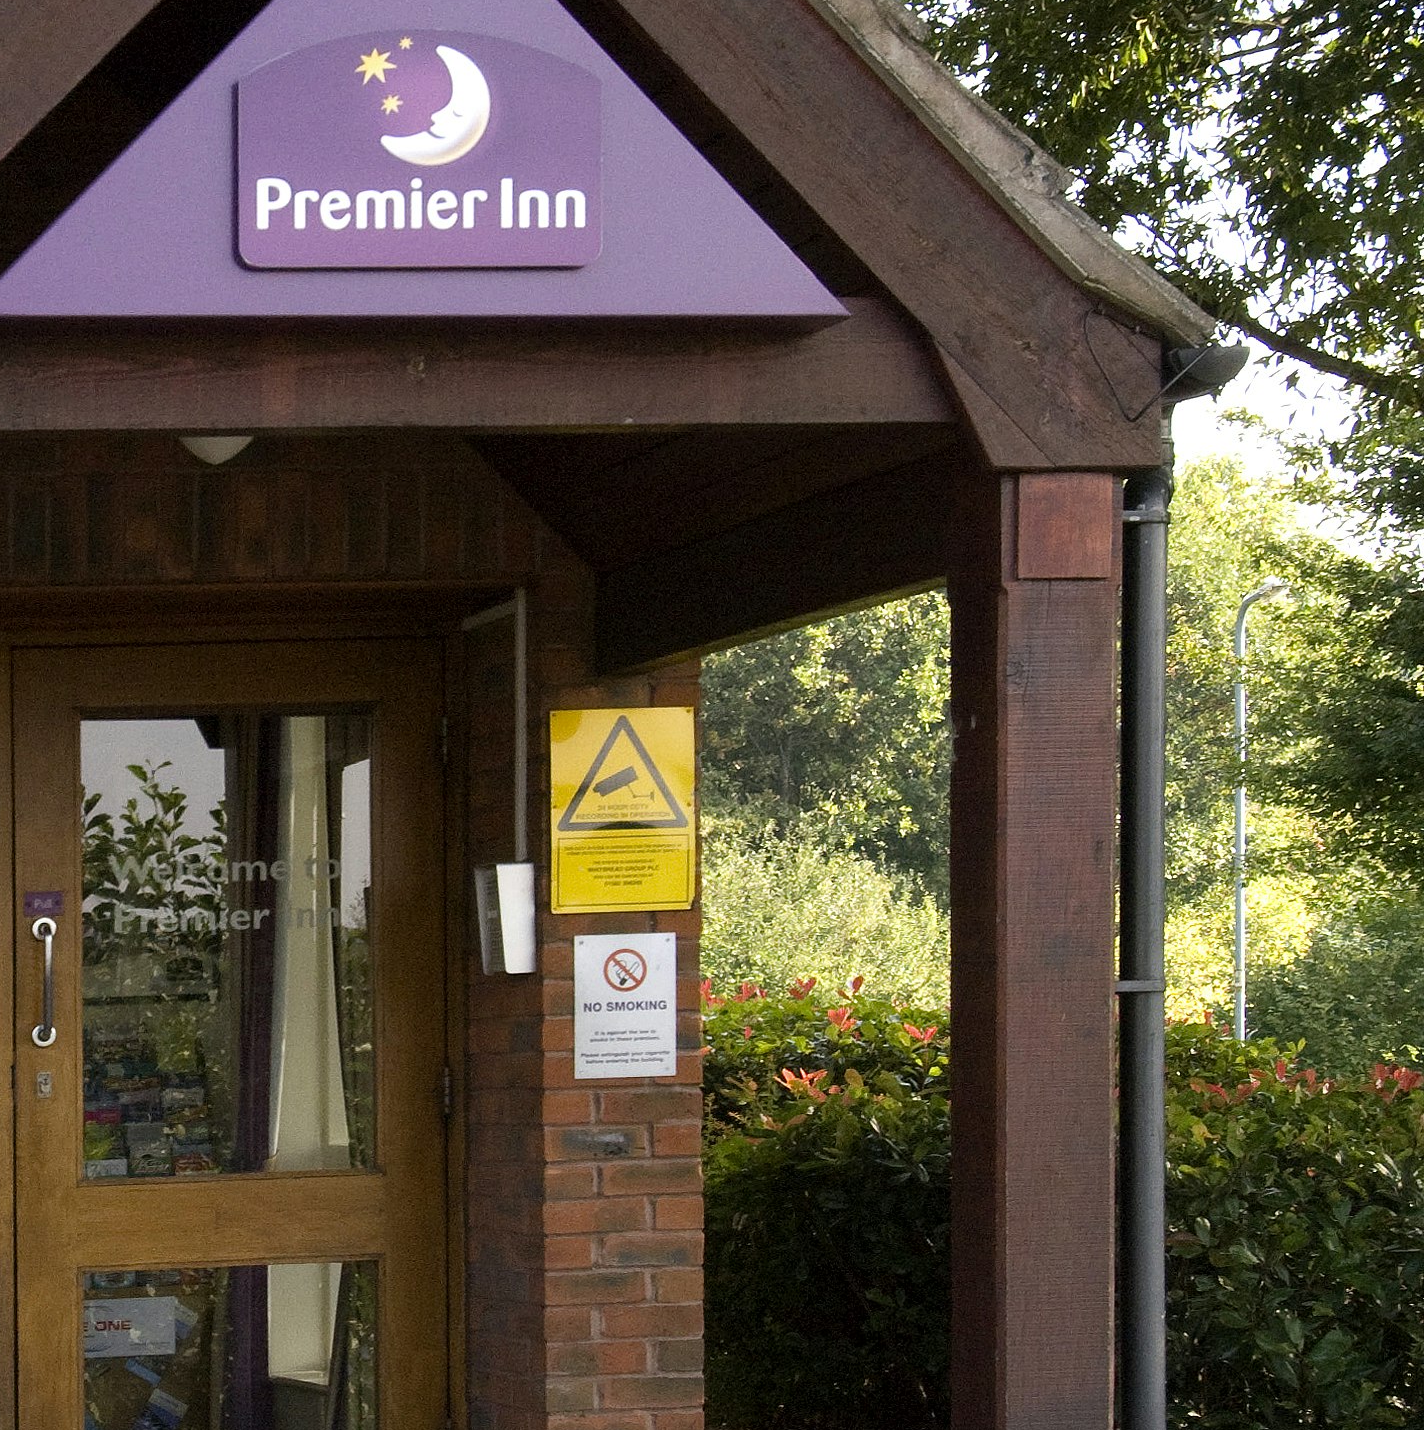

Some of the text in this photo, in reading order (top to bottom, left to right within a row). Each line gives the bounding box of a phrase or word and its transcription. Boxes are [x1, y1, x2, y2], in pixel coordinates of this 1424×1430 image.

[256, 177, 586, 231] Premier Inn
[108, 852, 291, 884] Welcome
[113, 904, 270, 934] Premier
[583, 1000, 668, 1013] NO SMOKING
